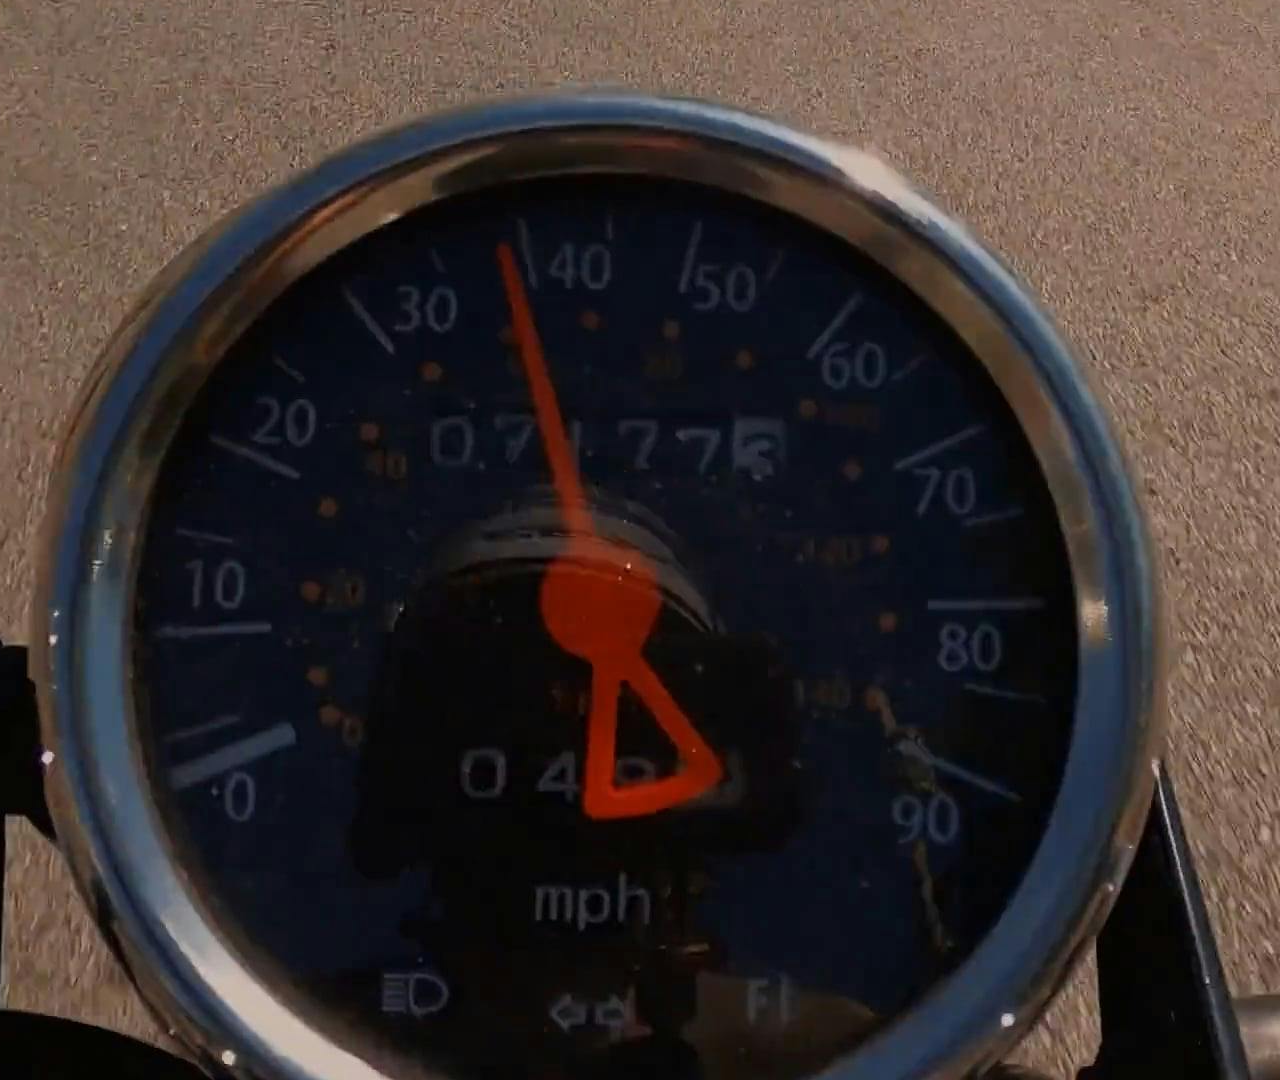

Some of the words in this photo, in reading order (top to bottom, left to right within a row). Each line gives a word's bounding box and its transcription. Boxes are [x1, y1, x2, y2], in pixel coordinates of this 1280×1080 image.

[550, 243, 612, 290] 40
[693, 264, 757, 312] 50
[394, 285, 458, 332] 30
[821, 342, 887, 390] 60
[253, 396, 316, 448] 20
[910, 466, 976, 517] 70
[184, 559, 244, 611] 10
[936, 622, 1001, 672] 80
[224, 771, 255, 823] 0
[891, 793, 959, 845] 90
[533, 872, 652, 932] mph
